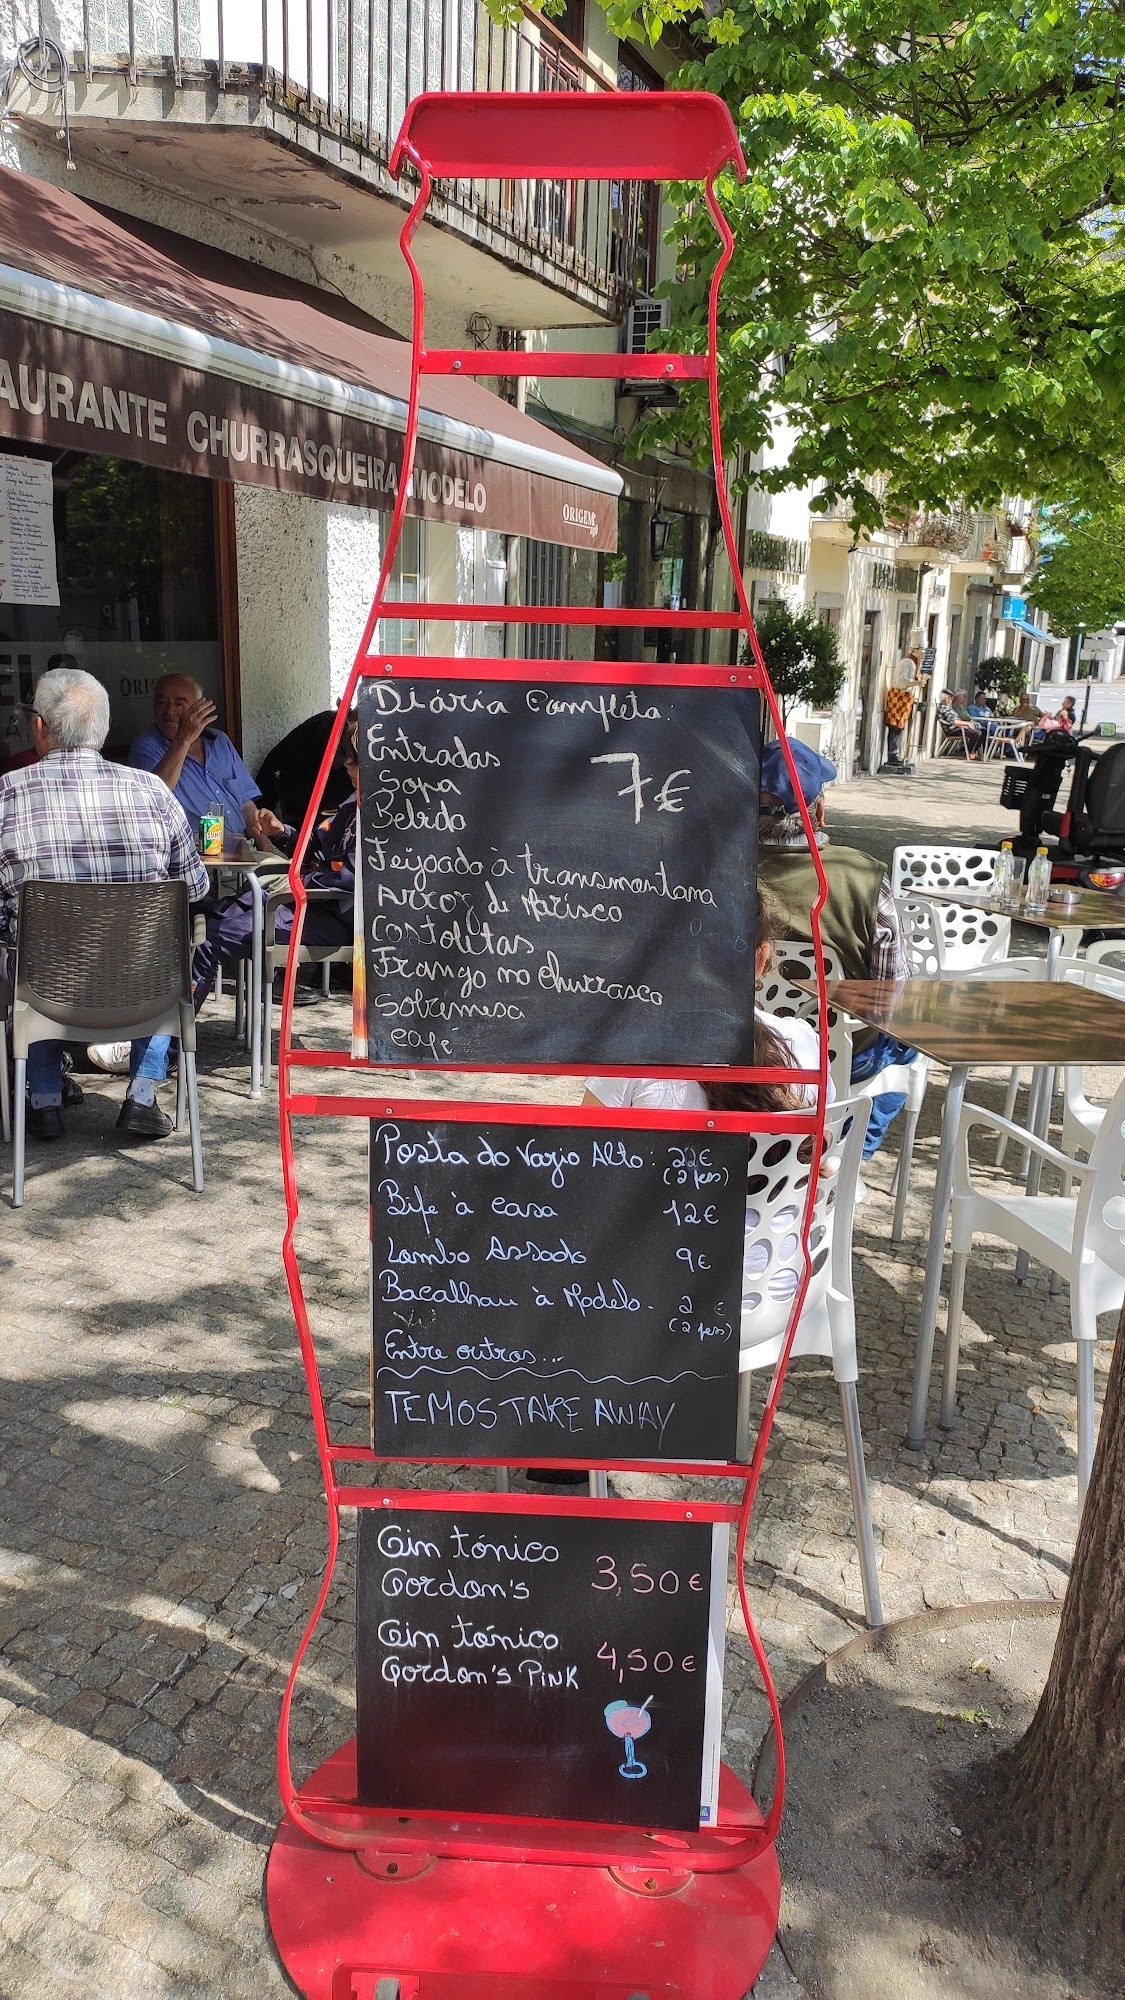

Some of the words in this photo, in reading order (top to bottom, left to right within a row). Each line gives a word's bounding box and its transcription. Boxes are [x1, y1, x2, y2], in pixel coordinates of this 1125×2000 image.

[0, 358, 168, 445] AURANTE
[186, 410, 399, 496] CHURRASQUEIRA
[412, 467, 487, 513] MODELO
[367, 723, 501, 770] Entradas
[378, 769, 461, 803] Sopa
[372, 946, 486, 998] Frango
[497, 966, 531, 986] no
[375, 988, 525, 1020] Sobremesa
[375, 1123, 469, 1165] Posta
[378, 1178, 439, 1235] Bife
[662, 1199, 719, 1226] 12€
[388, 1236, 470, 1265] Lombo
[485, 1235, 587, 1265] Assado
[379, 1269, 518, 1307] Bacalhau
[385, 1329, 448, 1361] Entre
[385, 1390, 498, 1430] TEMOS
[500, 1392, 584, 1432] TAKE
[595, 1397, 676, 1451] AWAY
[378, 1525, 441, 1558] Gin
[450, 1524, 560, 1562] tónico
[381, 1567, 530, 1599] Gordon's
[378, 1619, 440, 1648] Gin
[451, 1614, 559, 1650] tónico
[381, 1655, 512, 1687] Gordon's
